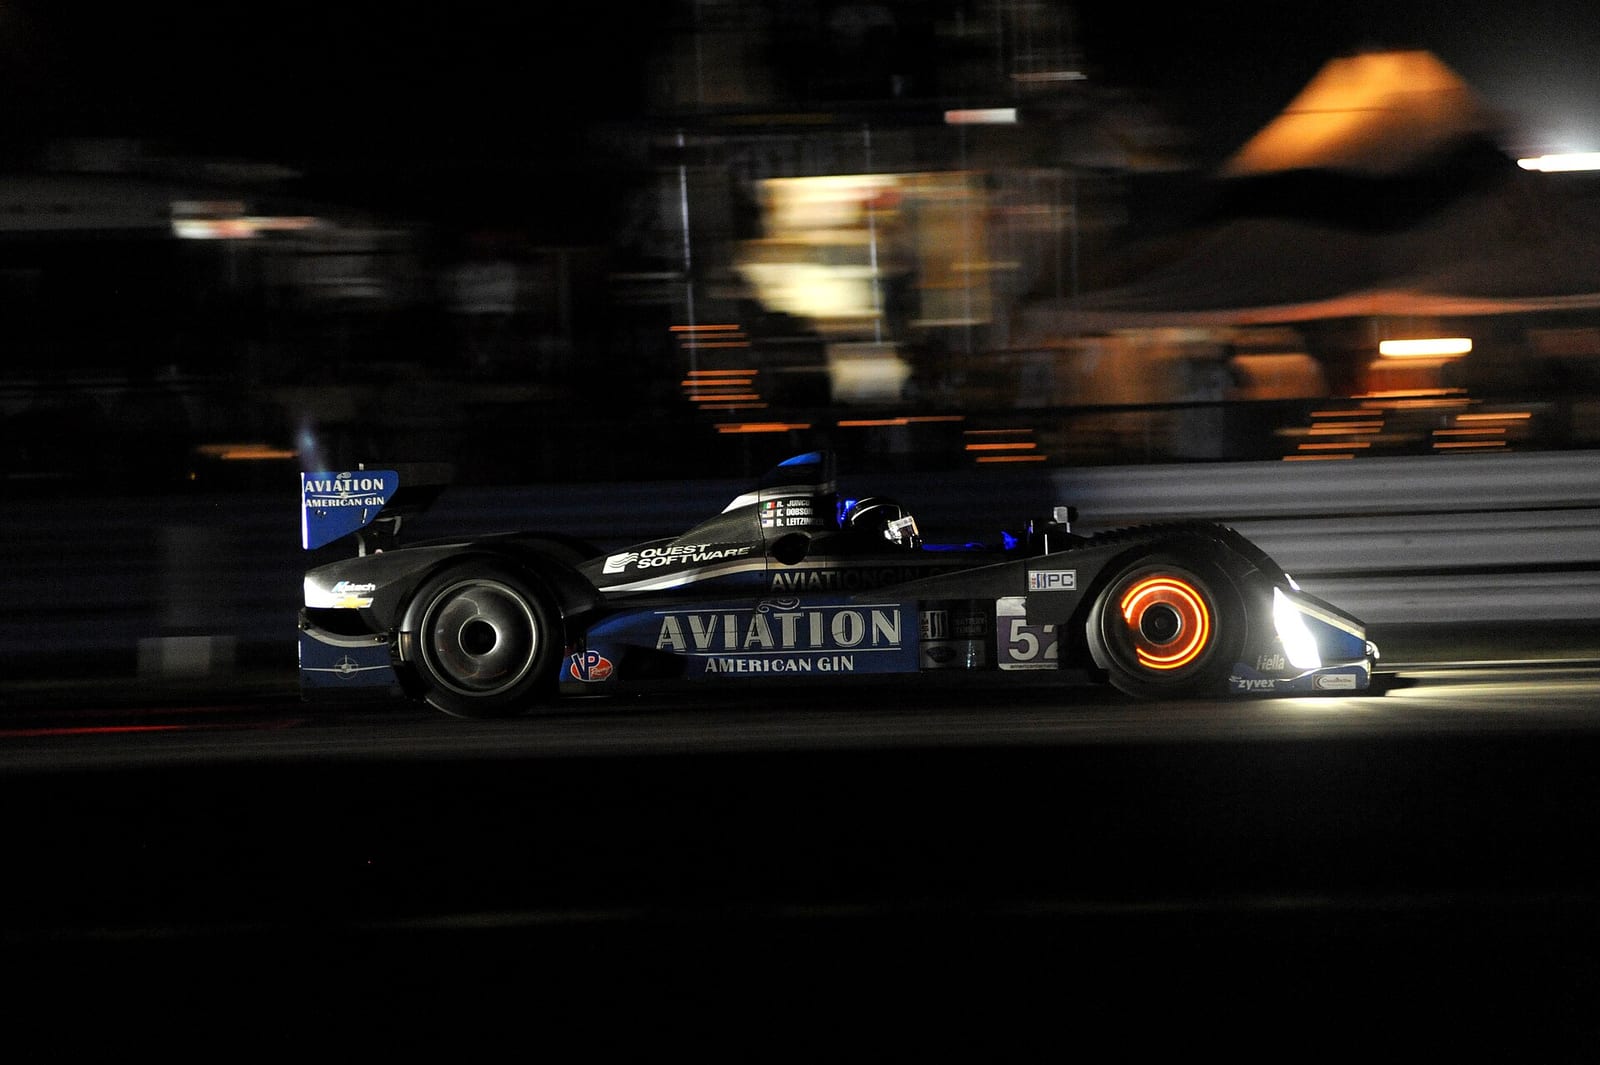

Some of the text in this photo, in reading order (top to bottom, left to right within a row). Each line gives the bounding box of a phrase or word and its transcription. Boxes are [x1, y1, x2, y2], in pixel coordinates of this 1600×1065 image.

[304, 478, 384, 493] AVIATION
[305, 497, 385, 508] AMERICAN GIN
[786, 508, 814, 516] DOBSON
[637, 546, 751, 569] SOFTWARE
[640, 543, 711, 558] QUEST
[656, 609, 902, 651] AVIATION
[570, 650, 601, 681] VP
[704, 654, 854, 673] AMERICAN GIN
[1238, 679, 1275, 690] zyvex
